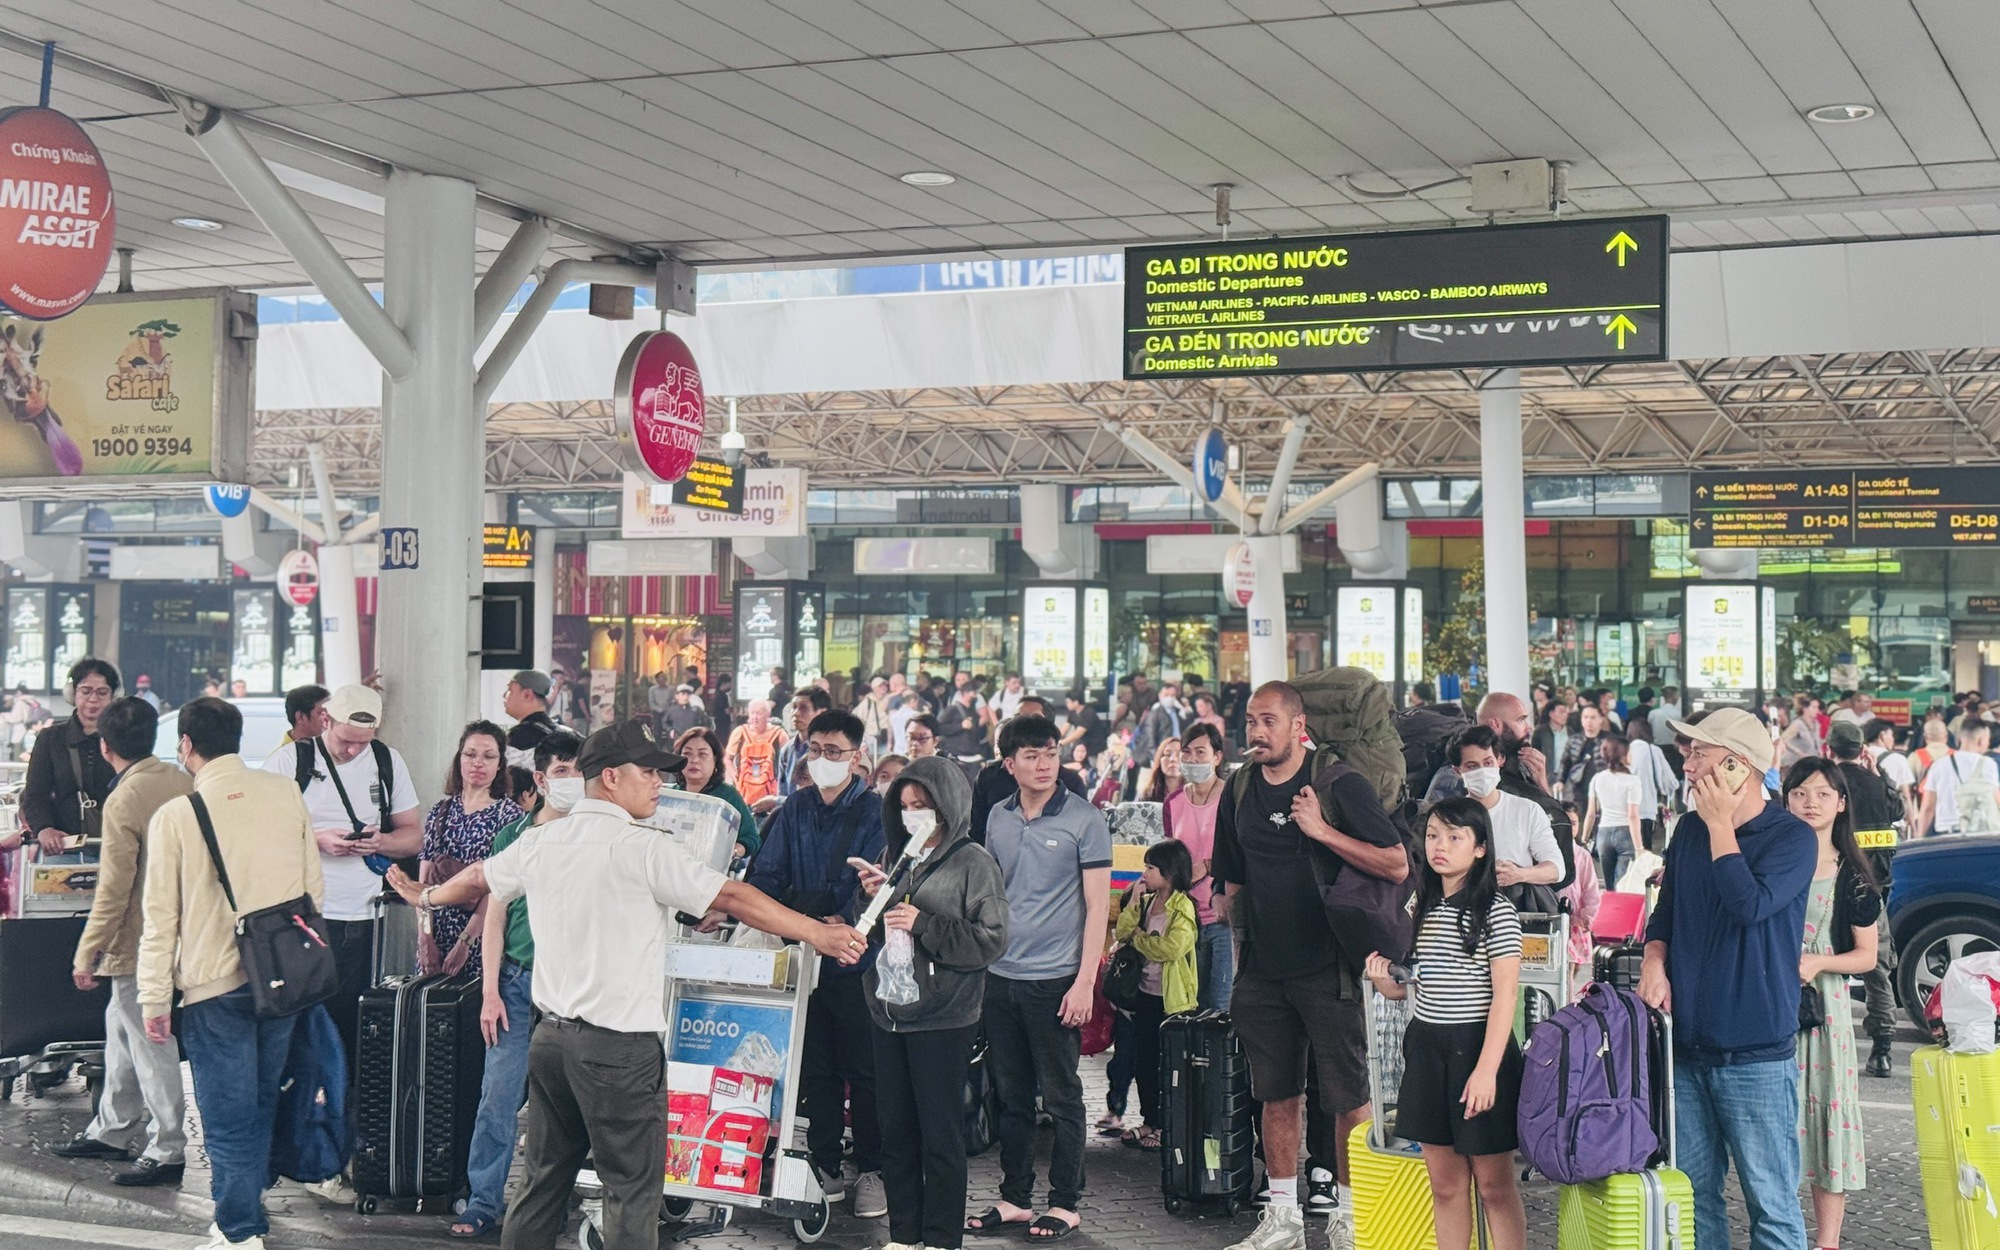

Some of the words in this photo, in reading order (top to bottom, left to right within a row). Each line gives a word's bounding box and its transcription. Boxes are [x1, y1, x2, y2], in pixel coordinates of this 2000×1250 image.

[12, 142, 61, 164] Chứng
[0, 178, 91, 215] MIRAE
[17, 214, 100, 249] ASSET
[1146, 259, 1176, 276] GA
[1180, 257, 1200, 275] ĐI
[1205, 252, 1278, 273] TRONG
[1284, 245, 1348, 269] NƯỚC
[1146, 277, 1216, 294] Domestic
[1220, 275, 1304, 293] Departures
[1147, 302, 1197, 312] VIETNAM
[1200, 298, 1253, 311] AIRLINES
[1263, 296, 1309, 308] PACIFIC
[1311, 292, 1368, 306] AIRLINES
[1378, 289, 1420, 302] VASCO
[1430, 286, 1487, 299] BAMBOO
[1490, 282, 1548, 296] AIRWAYS
[1147, 313, 1209, 326] VIETRAVEL
[1211, 310, 1265, 323] AIRLINES
[1145, 336, 1175, 353] GA
[1226, 331, 1299, 350] TRONG
[1305, 324, 1370, 347] NƯỚC
[1145, 356, 1215, 371] Domestic
[1217, 352, 1278, 369] Arrivals
[106, 373, 170, 401] Safari
[147, 425, 173, 434] NGAY
[92, 438, 139, 456] 1900
[144, 437, 192, 456] 9394
[217, 485, 243, 500] VIB
[1746, 484, 1774, 492] TRONG
[1804, 484, 1848, 497] A1-A3
[1858, 480, 1870, 488] GA
[1906, 488, 1940, 496] Terminal
[1736, 513, 1764, 521] TRONG
[1802, 514, 1849, 528] D1-D4
[1950, 514, 1998, 528] D5-D8
[506, 526, 520, 550] A
[680, 1018, 740, 1038] DORCO
